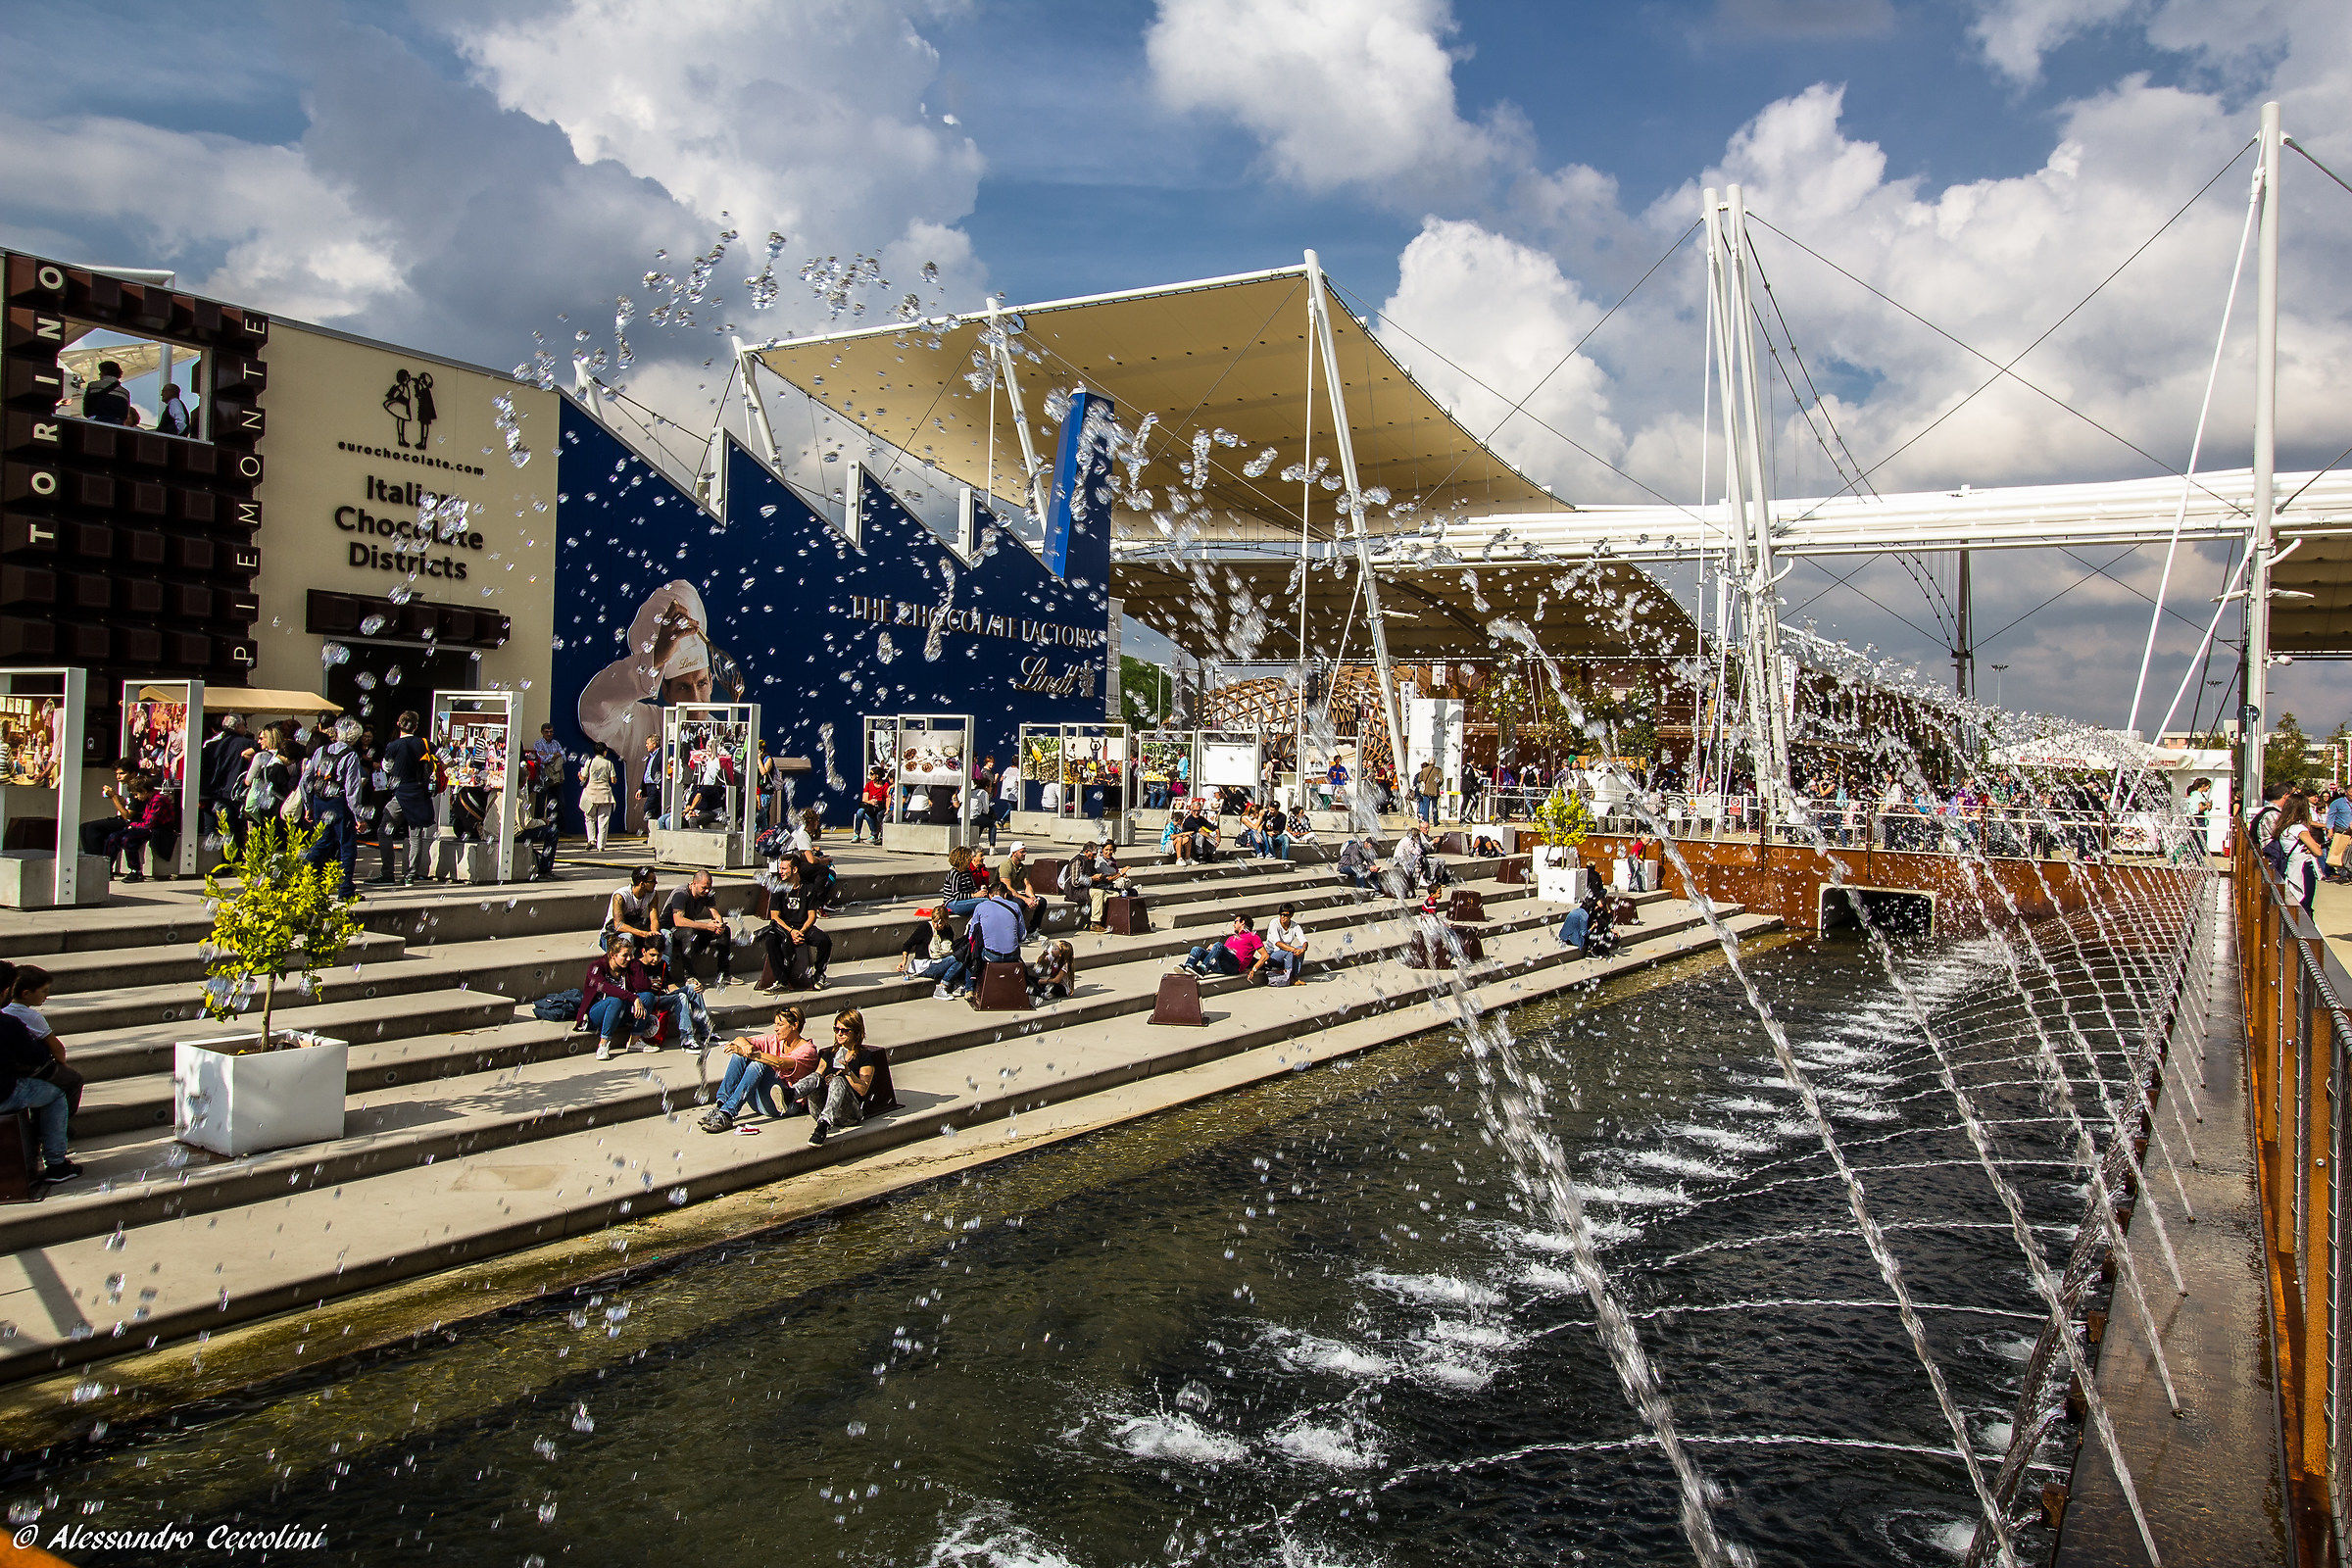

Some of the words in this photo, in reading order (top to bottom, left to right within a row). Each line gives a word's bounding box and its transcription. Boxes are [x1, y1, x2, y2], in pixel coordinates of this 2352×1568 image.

[29, 266, 64, 543] TORINO
[337, 441, 484, 475] eurochocolate.com
[234, 318, 266, 661] PIEMONTE
[367, 474, 456, 511] Itali
[349, 541, 467, 580] Districts
[852, 595, 892, 623] THE
[1022, 619, 1096, 649] FACTORY
[1012, 656, 1079, 694] Lindt
